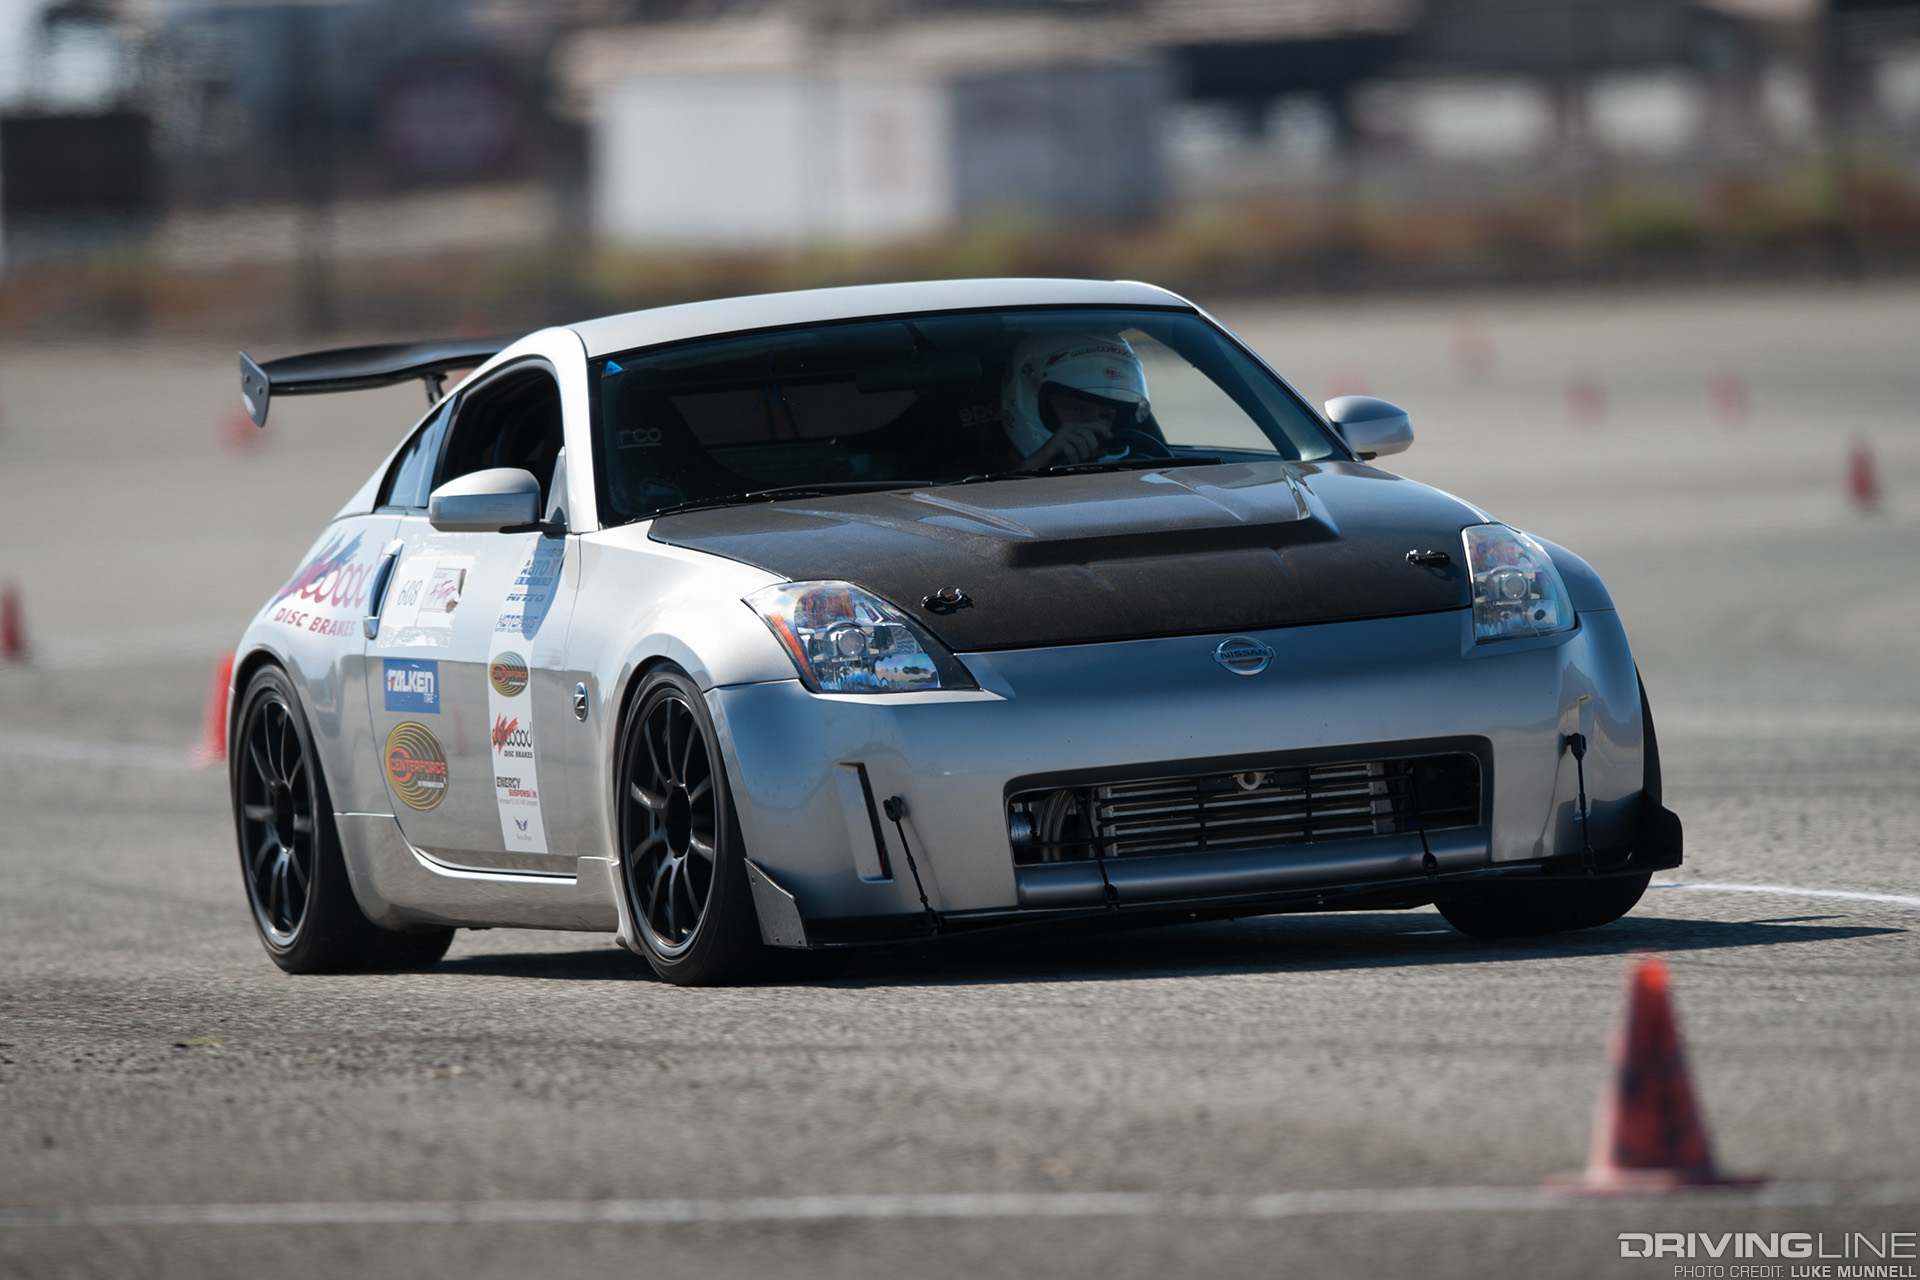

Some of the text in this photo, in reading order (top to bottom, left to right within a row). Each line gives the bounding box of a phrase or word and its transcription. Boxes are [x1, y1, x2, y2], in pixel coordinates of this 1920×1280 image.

[274, 607, 357, 637] DISC BRAKES
[1220, 649, 1268, 659] NISSAN
[385, 668, 435, 693] FALKEN
[491, 670, 528, 679] CENTERFORCE
[504, 750, 514, 758] DISC
[388, 755, 447, 776] CENTERFORCE
[496, 776, 521, 789] ENERGY
